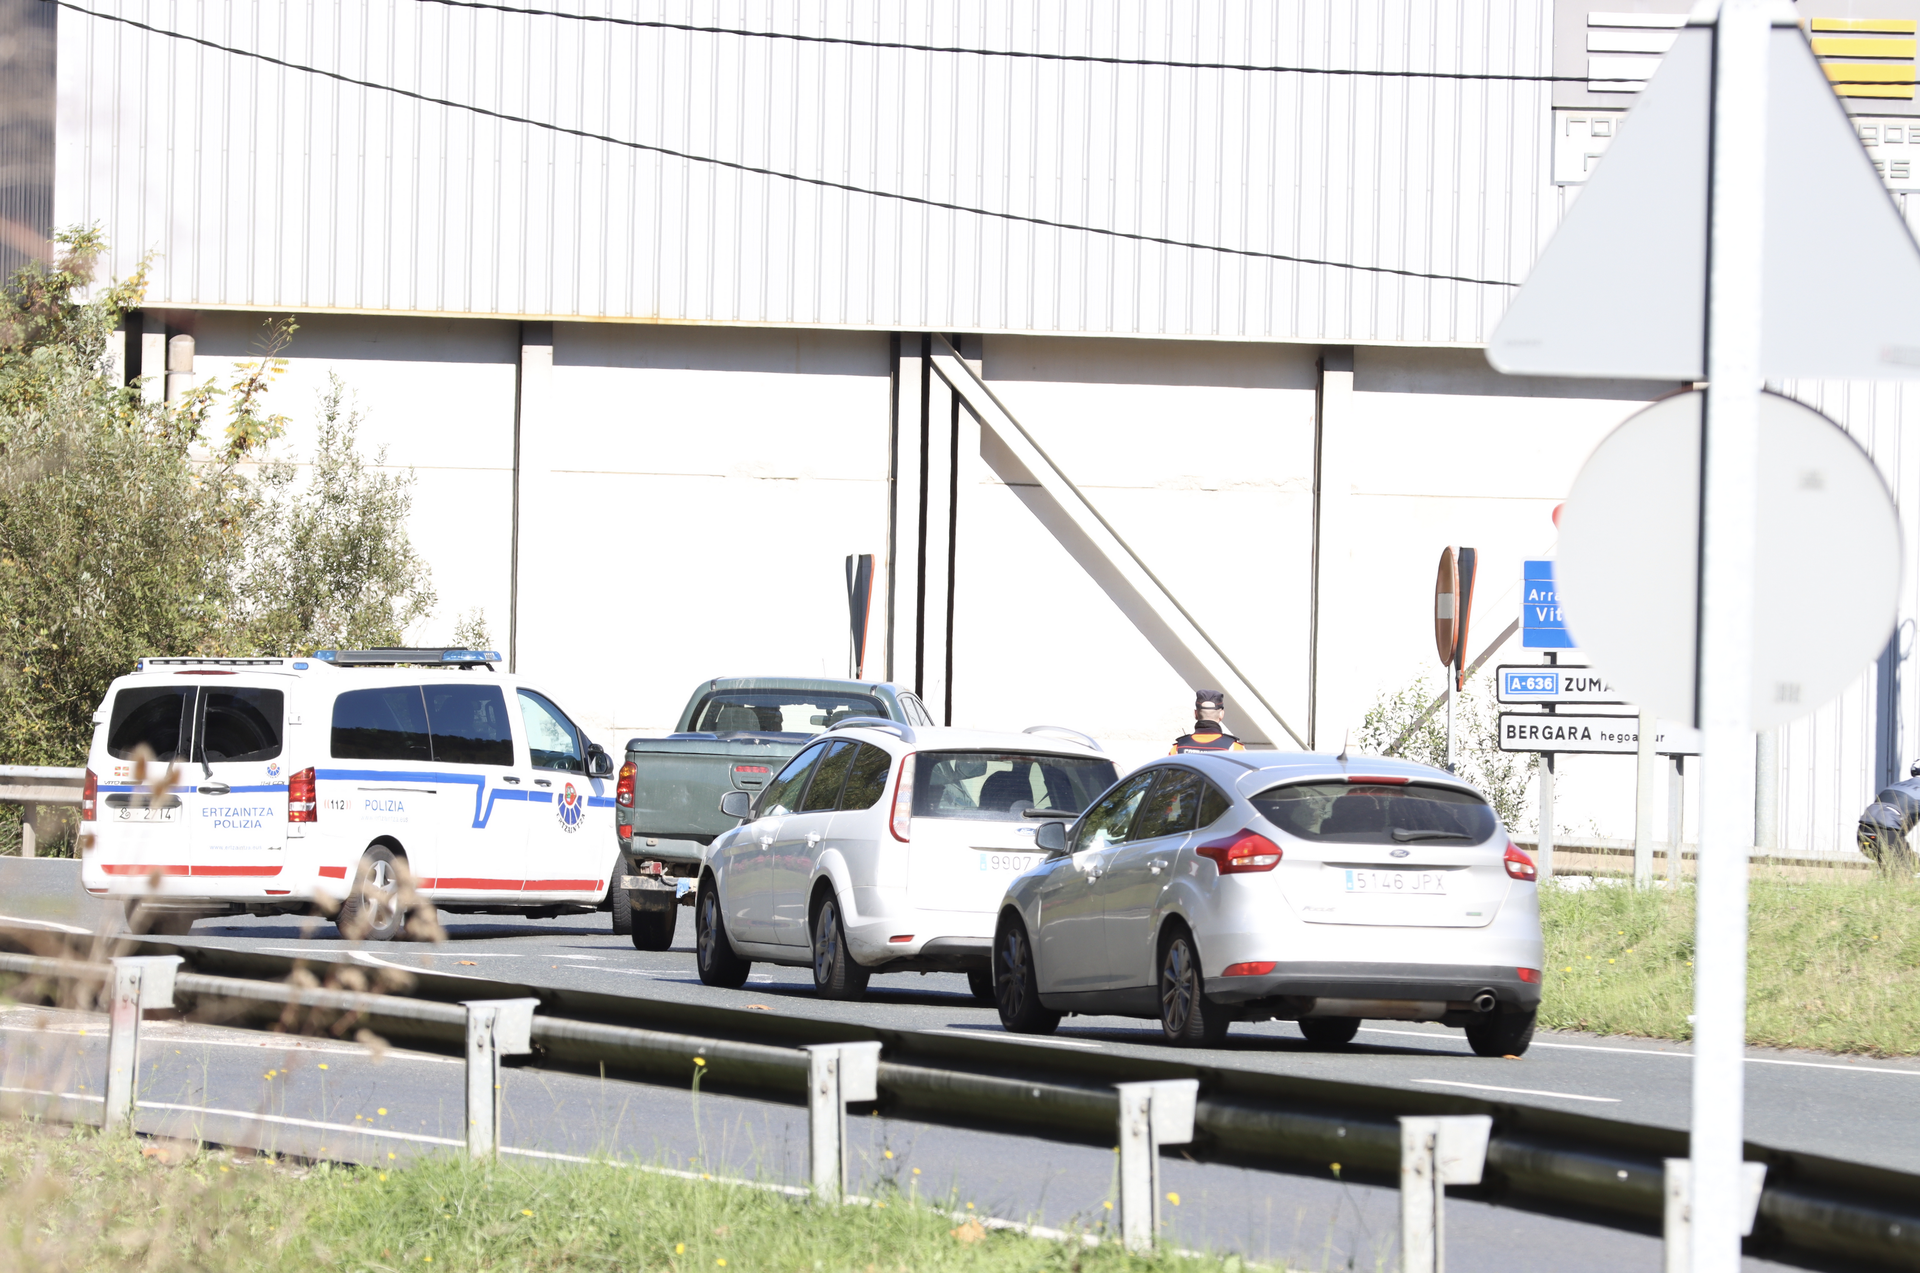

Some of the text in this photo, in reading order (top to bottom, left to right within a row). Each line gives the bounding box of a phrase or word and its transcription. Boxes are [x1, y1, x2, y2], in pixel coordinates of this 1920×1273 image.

[1528, 588, 1560, 601] Arra
[1536, 607, 1563, 622] Vit
[1511, 677, 1615, 692] A-636 ZUMA
[1506, 725, 1592, 740] BERGARA
[202, 807, 274, 817] ERTZAINTZA
[364, 799, 405, 812] POLIZIA
[213, 819, 262, 829] POLIZIA
[991, 855, 1031, 871] 9907
[1357, 873, 1444, 890] 5146 JPX
